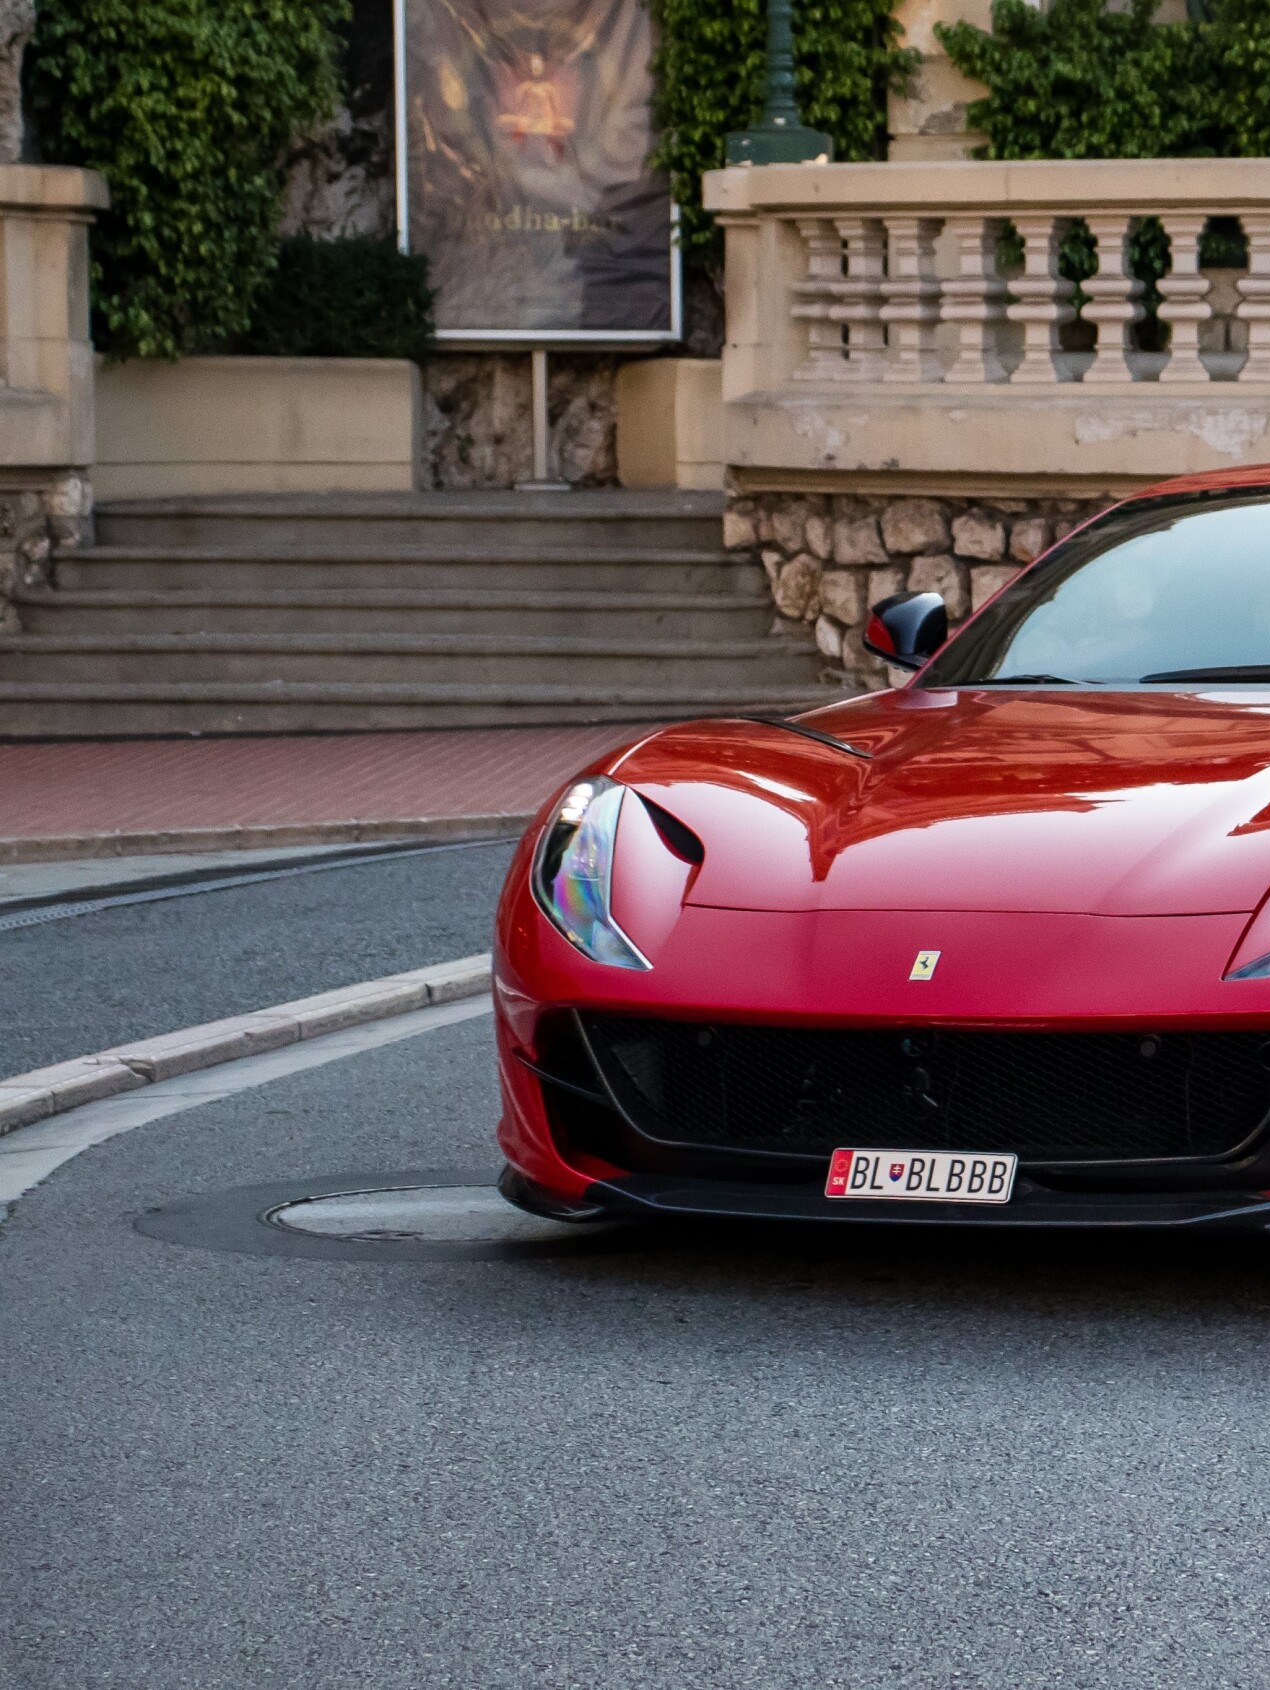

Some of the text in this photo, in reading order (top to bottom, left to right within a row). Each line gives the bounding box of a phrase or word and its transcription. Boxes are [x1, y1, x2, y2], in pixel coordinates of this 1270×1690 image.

[832, 1176, 846, 1186] SK
[850, 1156, 1008, 1194] BL BLBBB
